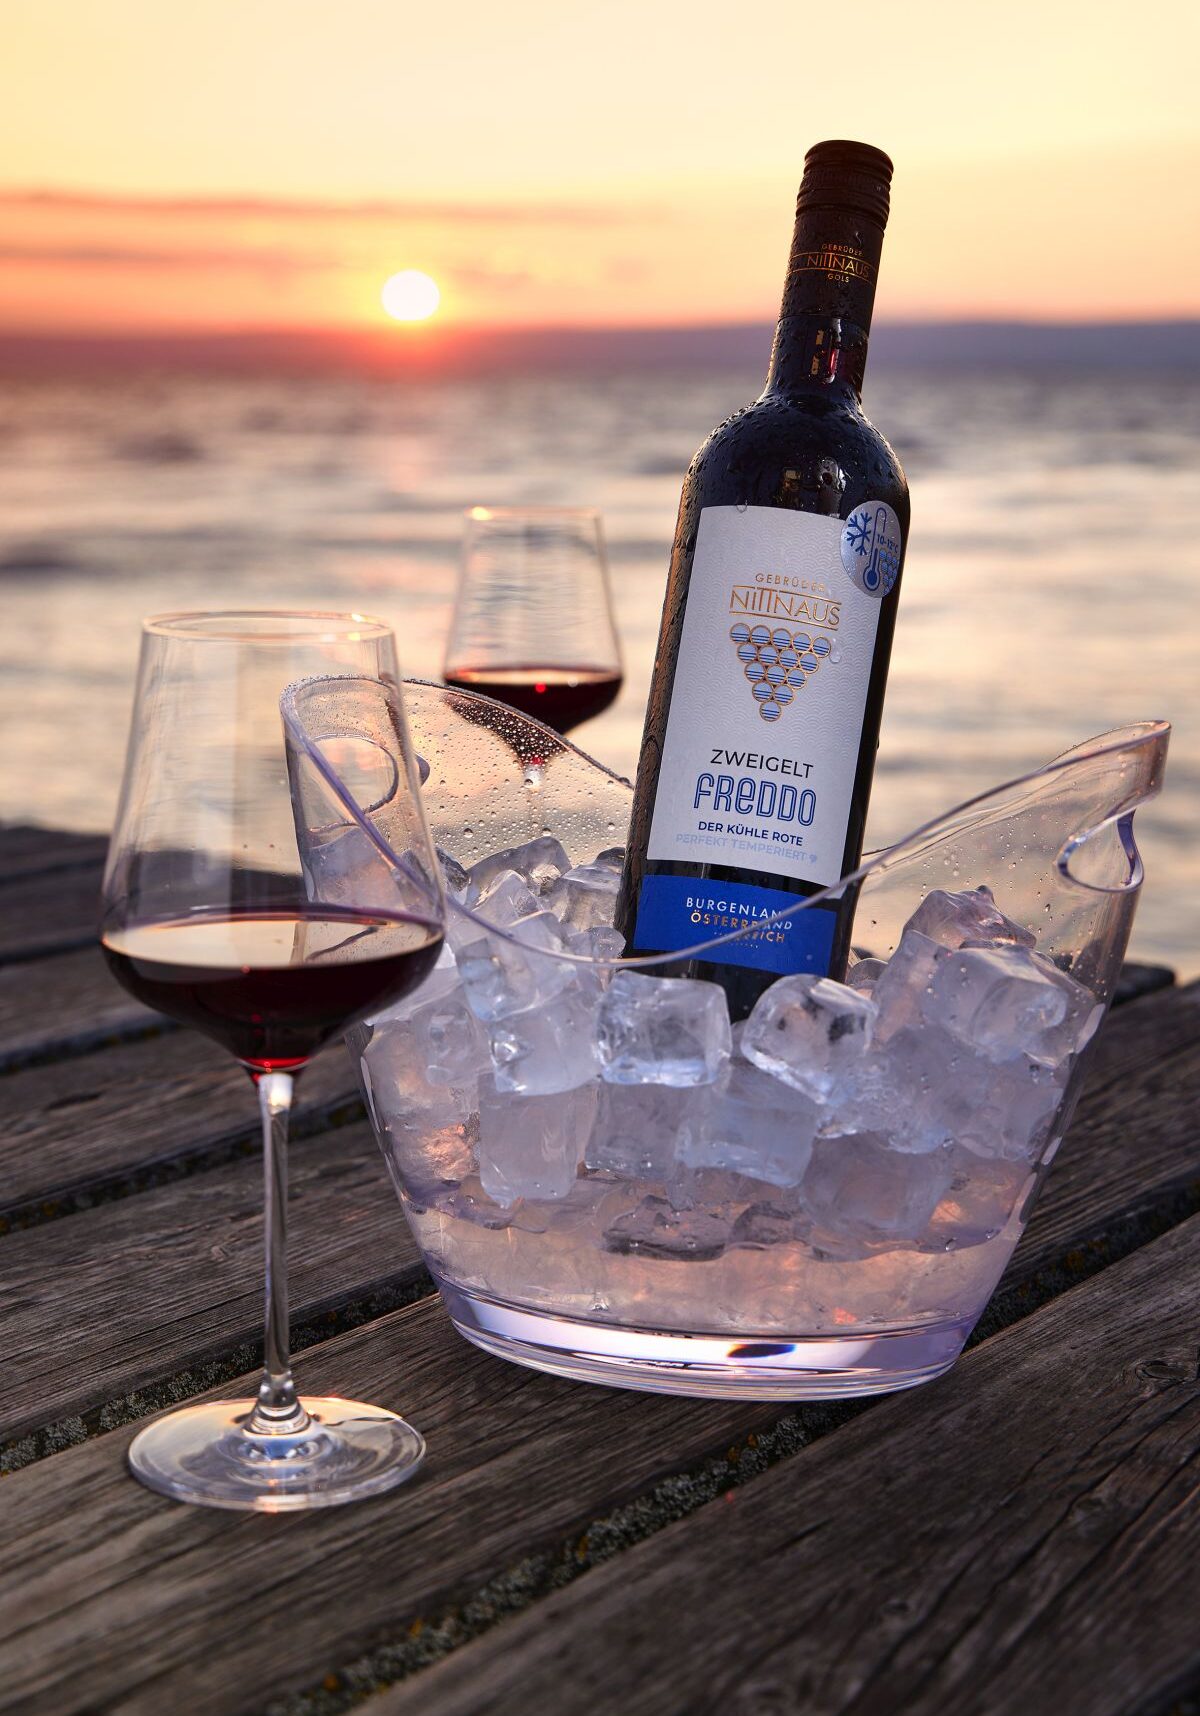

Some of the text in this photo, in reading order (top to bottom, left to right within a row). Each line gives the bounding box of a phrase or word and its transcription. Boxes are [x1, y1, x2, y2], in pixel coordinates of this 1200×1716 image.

[827, 273, 850, 283] GOLS
[729, 587, 842, 626] NITTNAUS
[710, 749, 814, 779] ZWEIGELT
[676, 833, 808, 862] PERFEKT TEMPERIERT
[698, 821, 804, 847] DER KÜHLE ROTE
